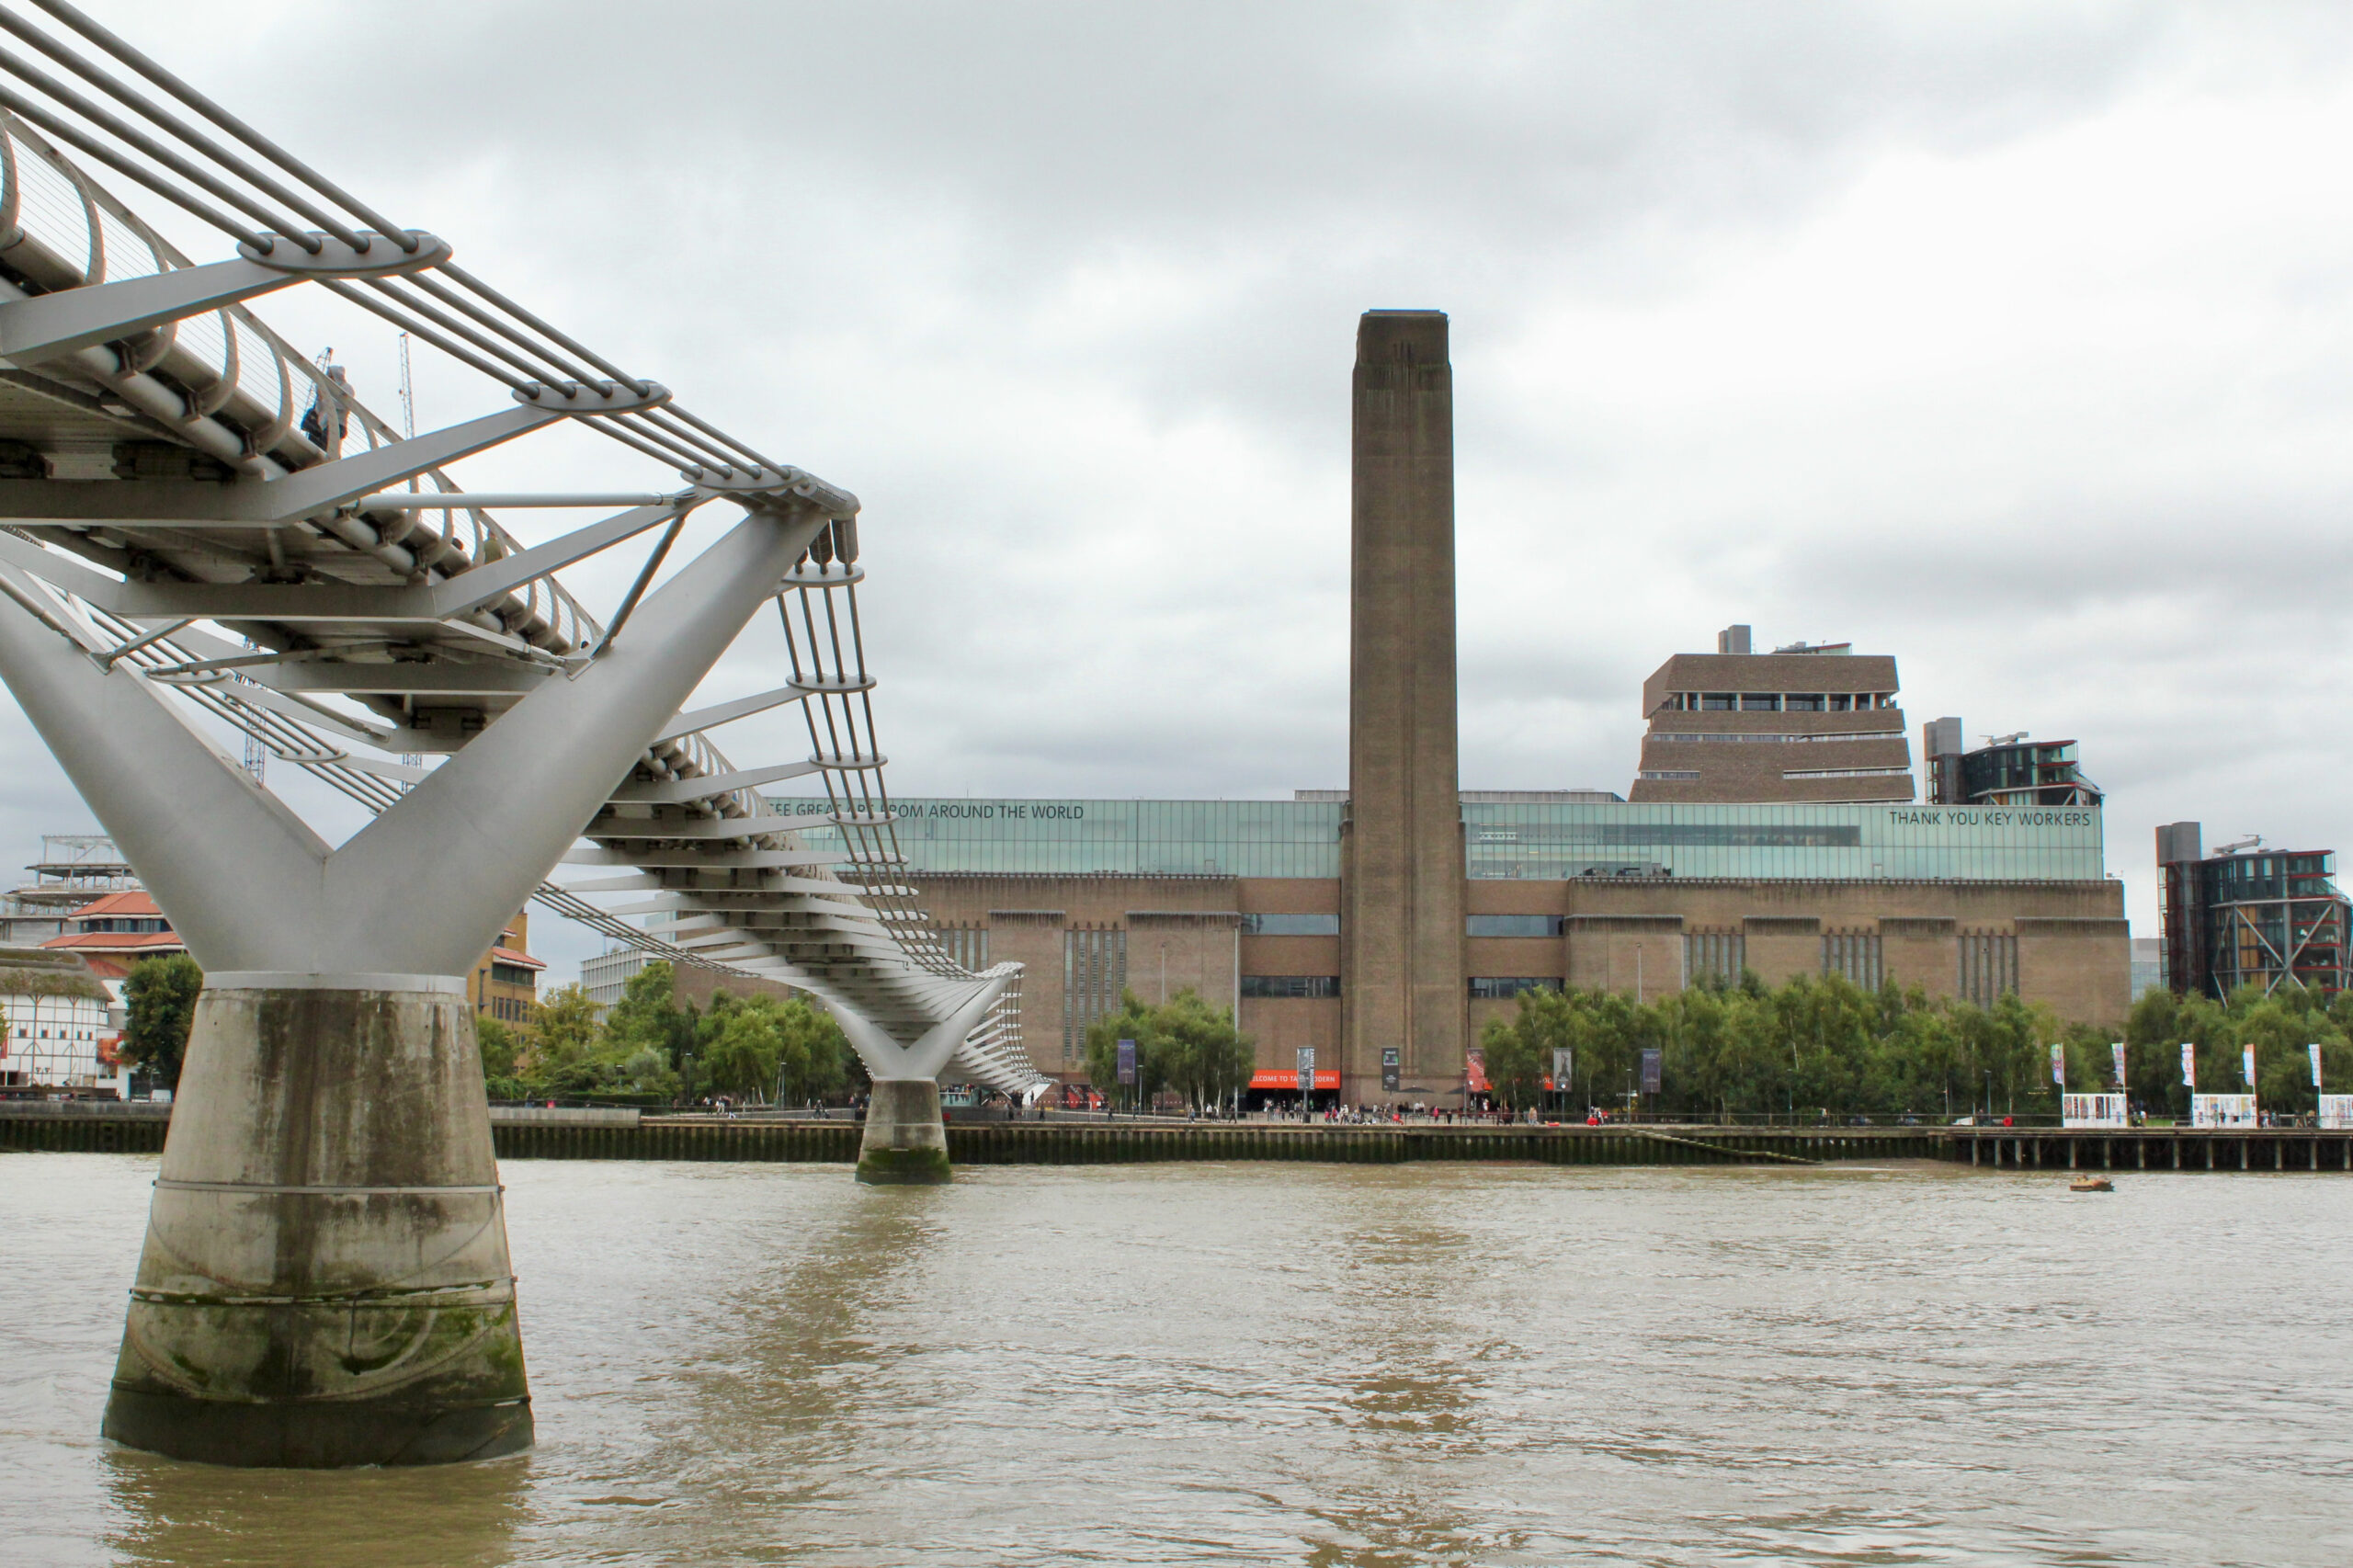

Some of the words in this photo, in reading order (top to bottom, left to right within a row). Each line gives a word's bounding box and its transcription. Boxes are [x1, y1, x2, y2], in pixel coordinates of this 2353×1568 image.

[769, 802, 790, 816] EE
[928, 804, 994, 819] AROUND
[998, 805, 1026, 818] THE
[1031, 805, 1084, 819] WORLD
[1890, 812, 1941, 825] THANK
[1948, 812, 1979, 825] YOU
[1984, 812, 2012, 825] KEY
[2018, 812, 2091, 826] WORKERS
[1314, 1075, 1336, 1084] ODERN
